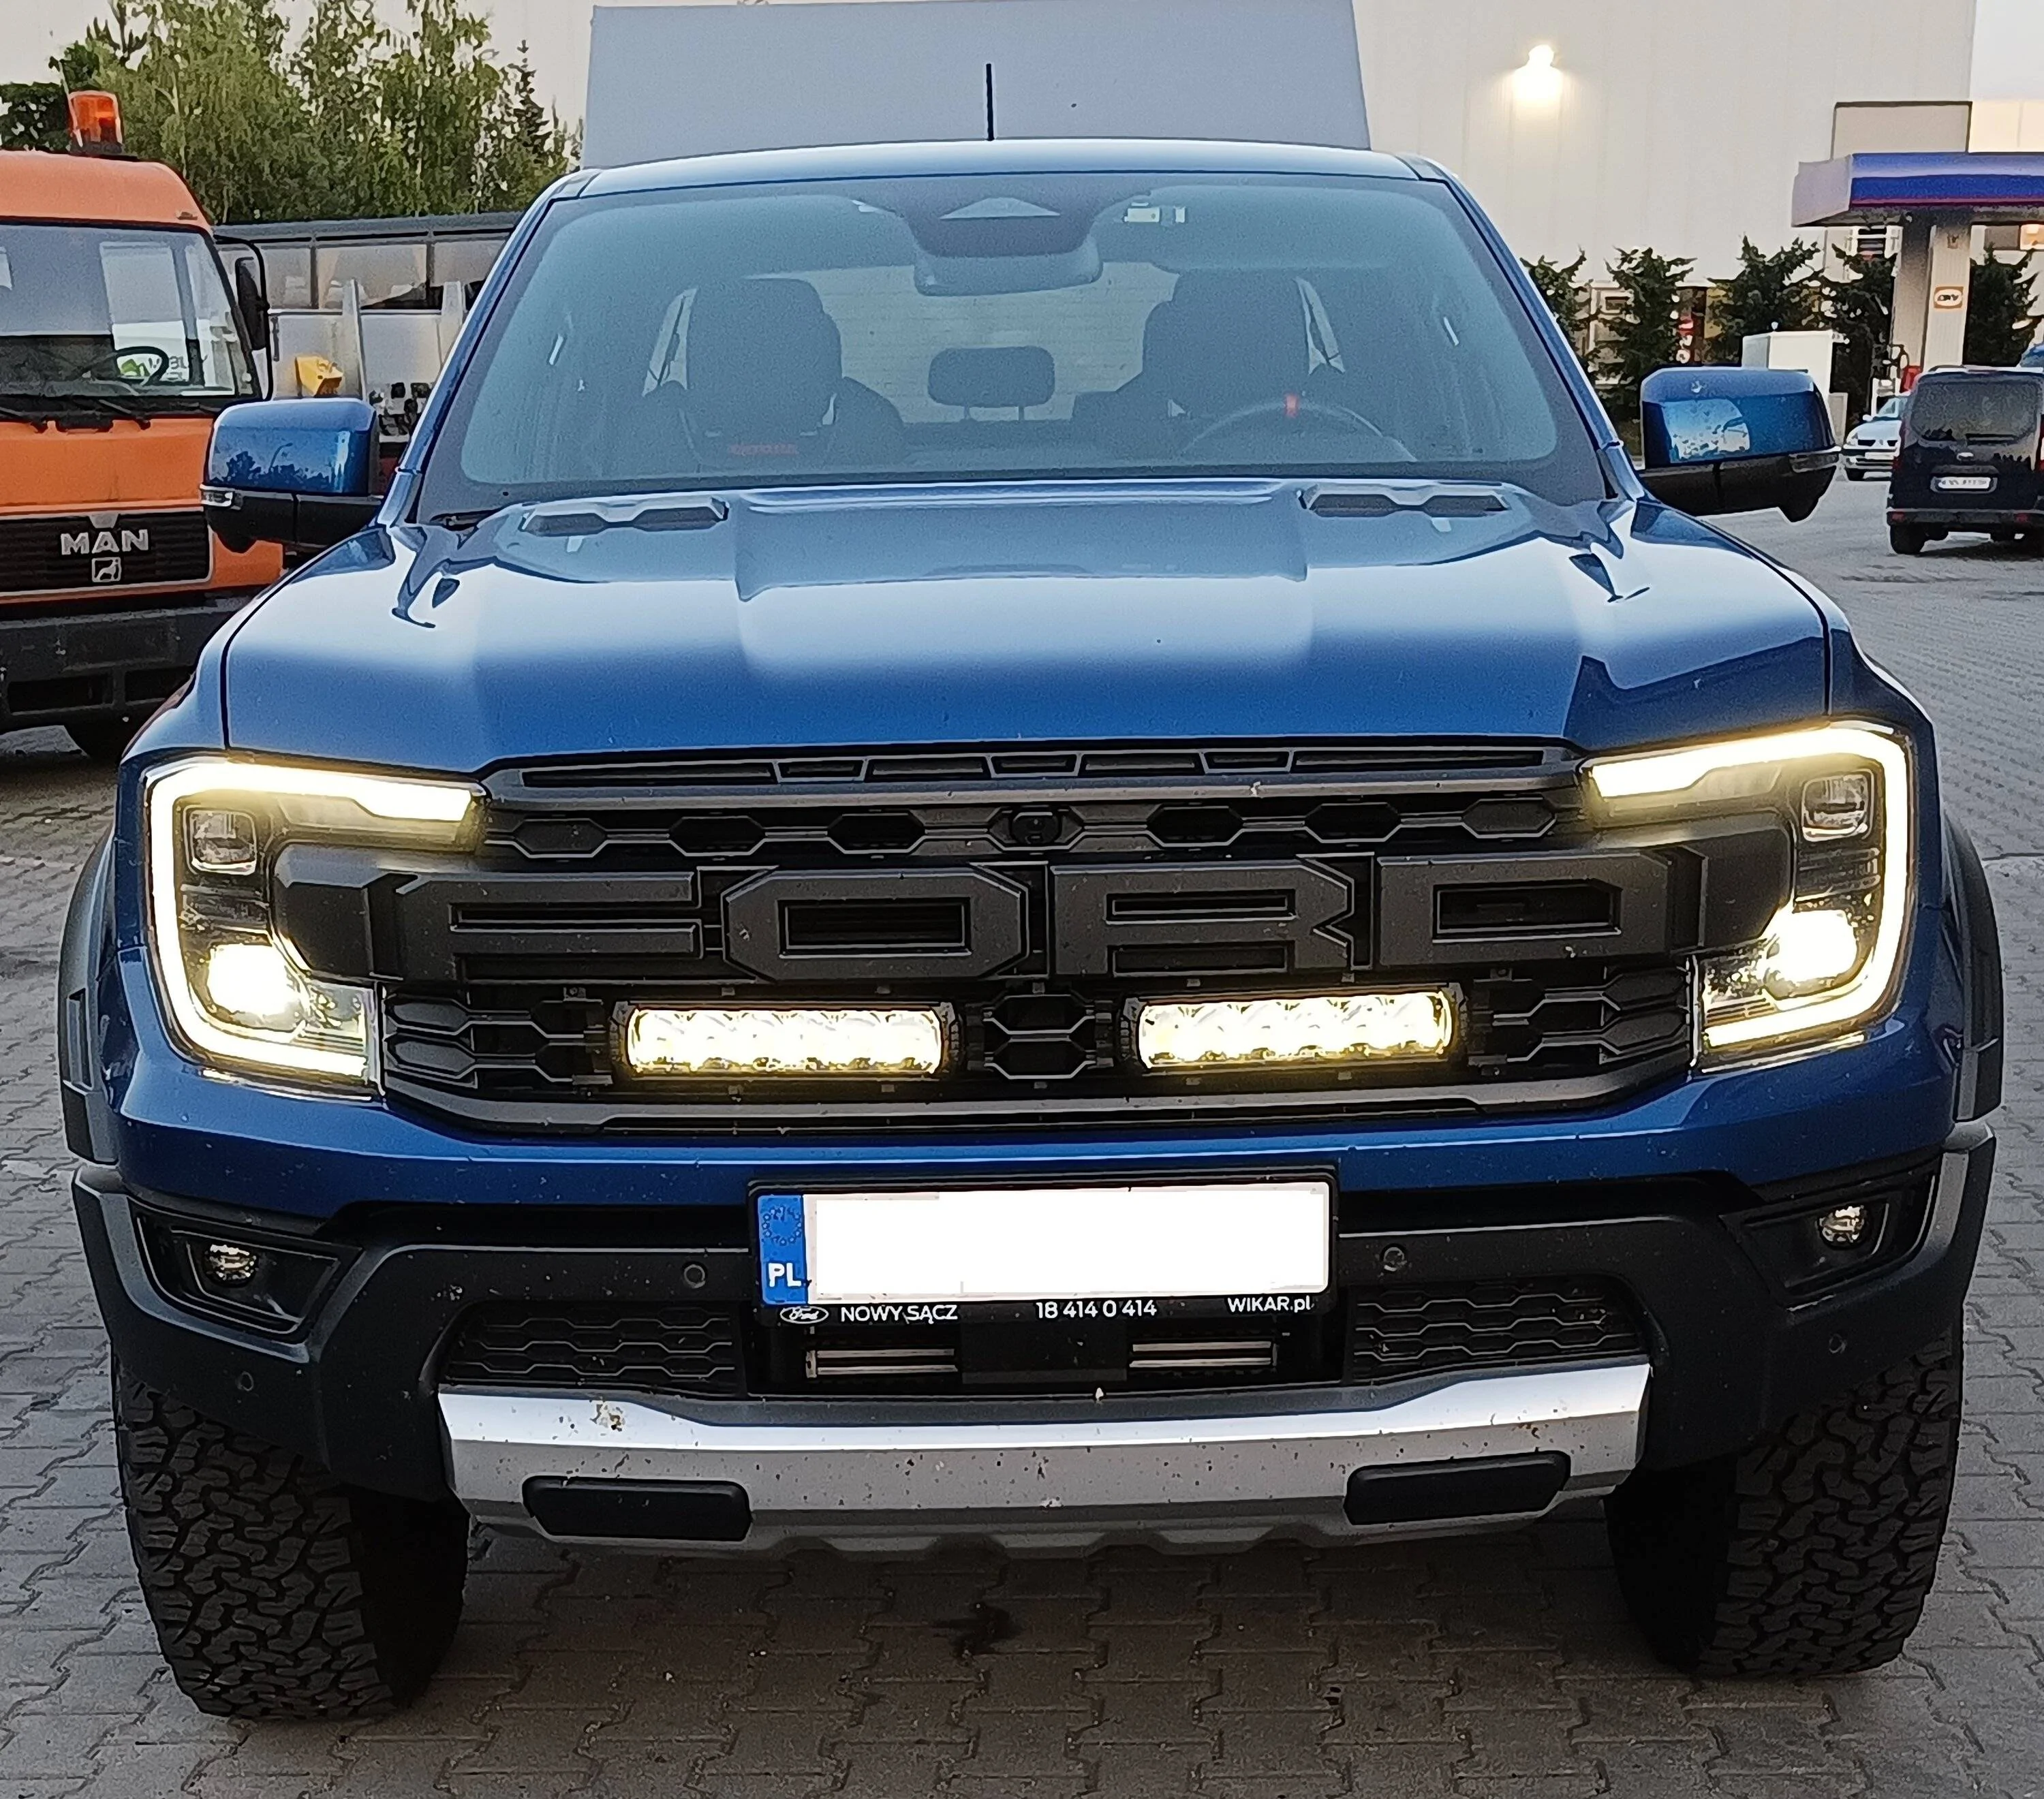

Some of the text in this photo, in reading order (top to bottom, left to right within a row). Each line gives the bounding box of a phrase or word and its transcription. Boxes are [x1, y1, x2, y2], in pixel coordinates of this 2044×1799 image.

[60, 529, 149, 555] MAN
[395, 851, 1673, 980] FORD
[768, 1262, 802, 1287] PL
[841, 1305, 903, 1322] NOWY
[907, 1304, 958, 1324] SĄCZ
[1036, 1300, 1058, 1319] 18
[1063, 1300, 1098, 1318] 414
[1121, 1299, 1157, 1317] 414
[1227, 1295, 1311, 1313] WIKAR.pl
